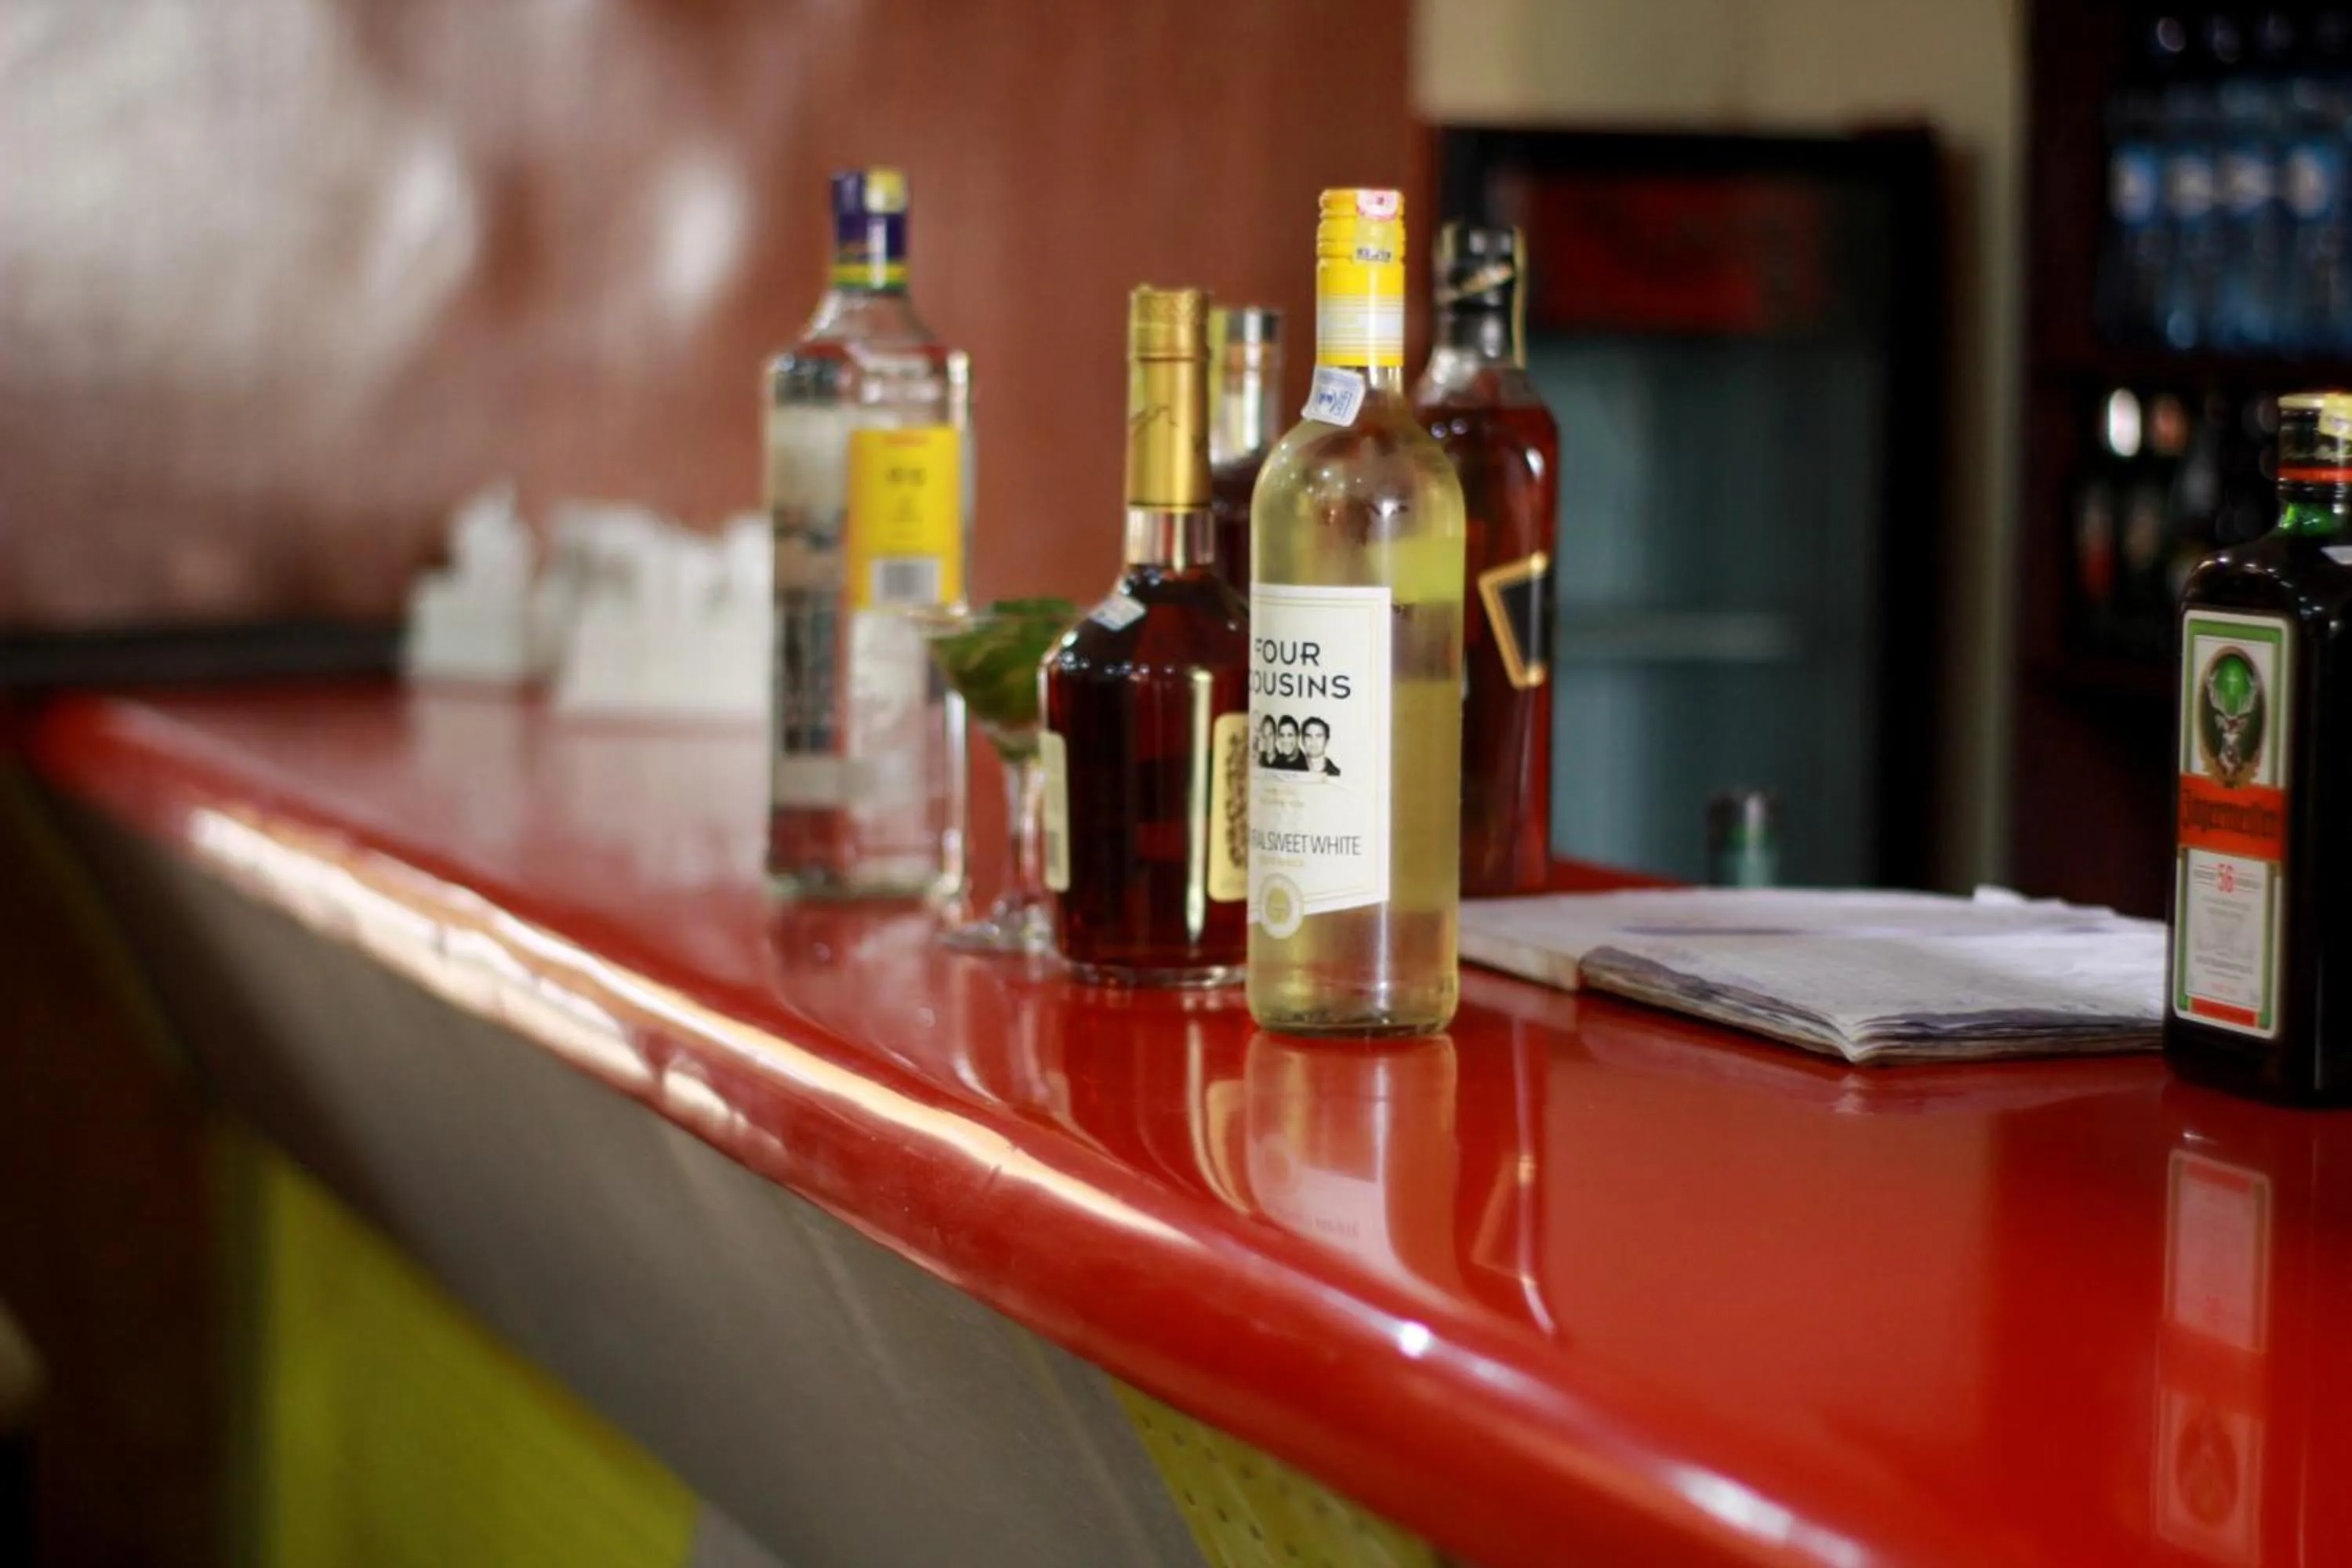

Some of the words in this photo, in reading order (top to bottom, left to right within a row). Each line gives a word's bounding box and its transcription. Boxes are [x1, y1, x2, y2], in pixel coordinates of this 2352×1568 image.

[1254, 638, 1320, 666] FOUR
[1251, 670, 1352, 699] OUSINS
[1267, 831, 1309, 854] SWEET
[1310, 834, 1362, 856] WHITE
